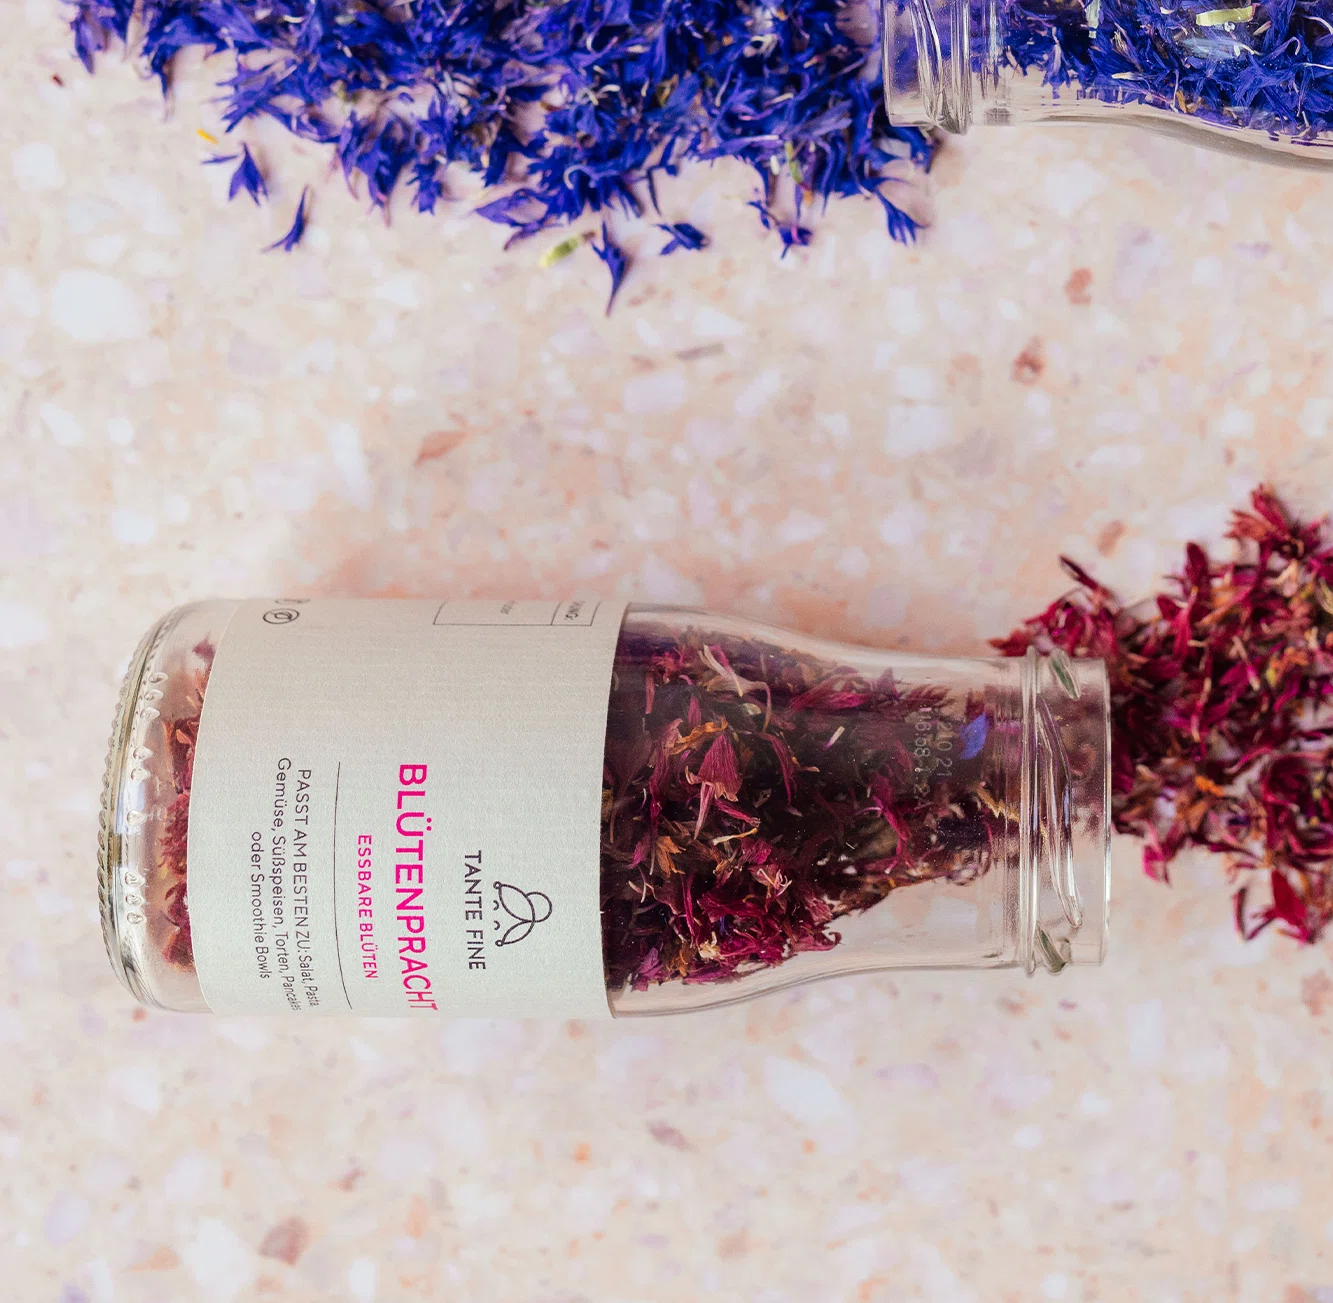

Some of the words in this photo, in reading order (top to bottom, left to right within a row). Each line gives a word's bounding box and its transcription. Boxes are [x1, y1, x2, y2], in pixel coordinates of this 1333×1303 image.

[271, 758, 291, 831] Gemüse,
[295, 770, 312, 825] PASST
[251, 832, 264, 870] oder
[294, 829, 307, 857] AM
[269, 836, 286, 928] Süßspeisen,
[293, 863, 308, 927] BESTEN
[358, 835, 372, 918] ESSBARE
[395, 764, 438, 1010] BLÜTENPRACHT
[465, 850, 482, 920] TANTE
[251, 874, 267, 943] Smoothie
[256, 947, 272, 978] Bowls
[275, 932, 289, 973] Torten,
[296, 931, 310, 952] ZU:
[360, 923, 378, 978] BLÜTEN
[466, 930, 486, 969] FINE
[299, 955, 314, 984] Salat,
